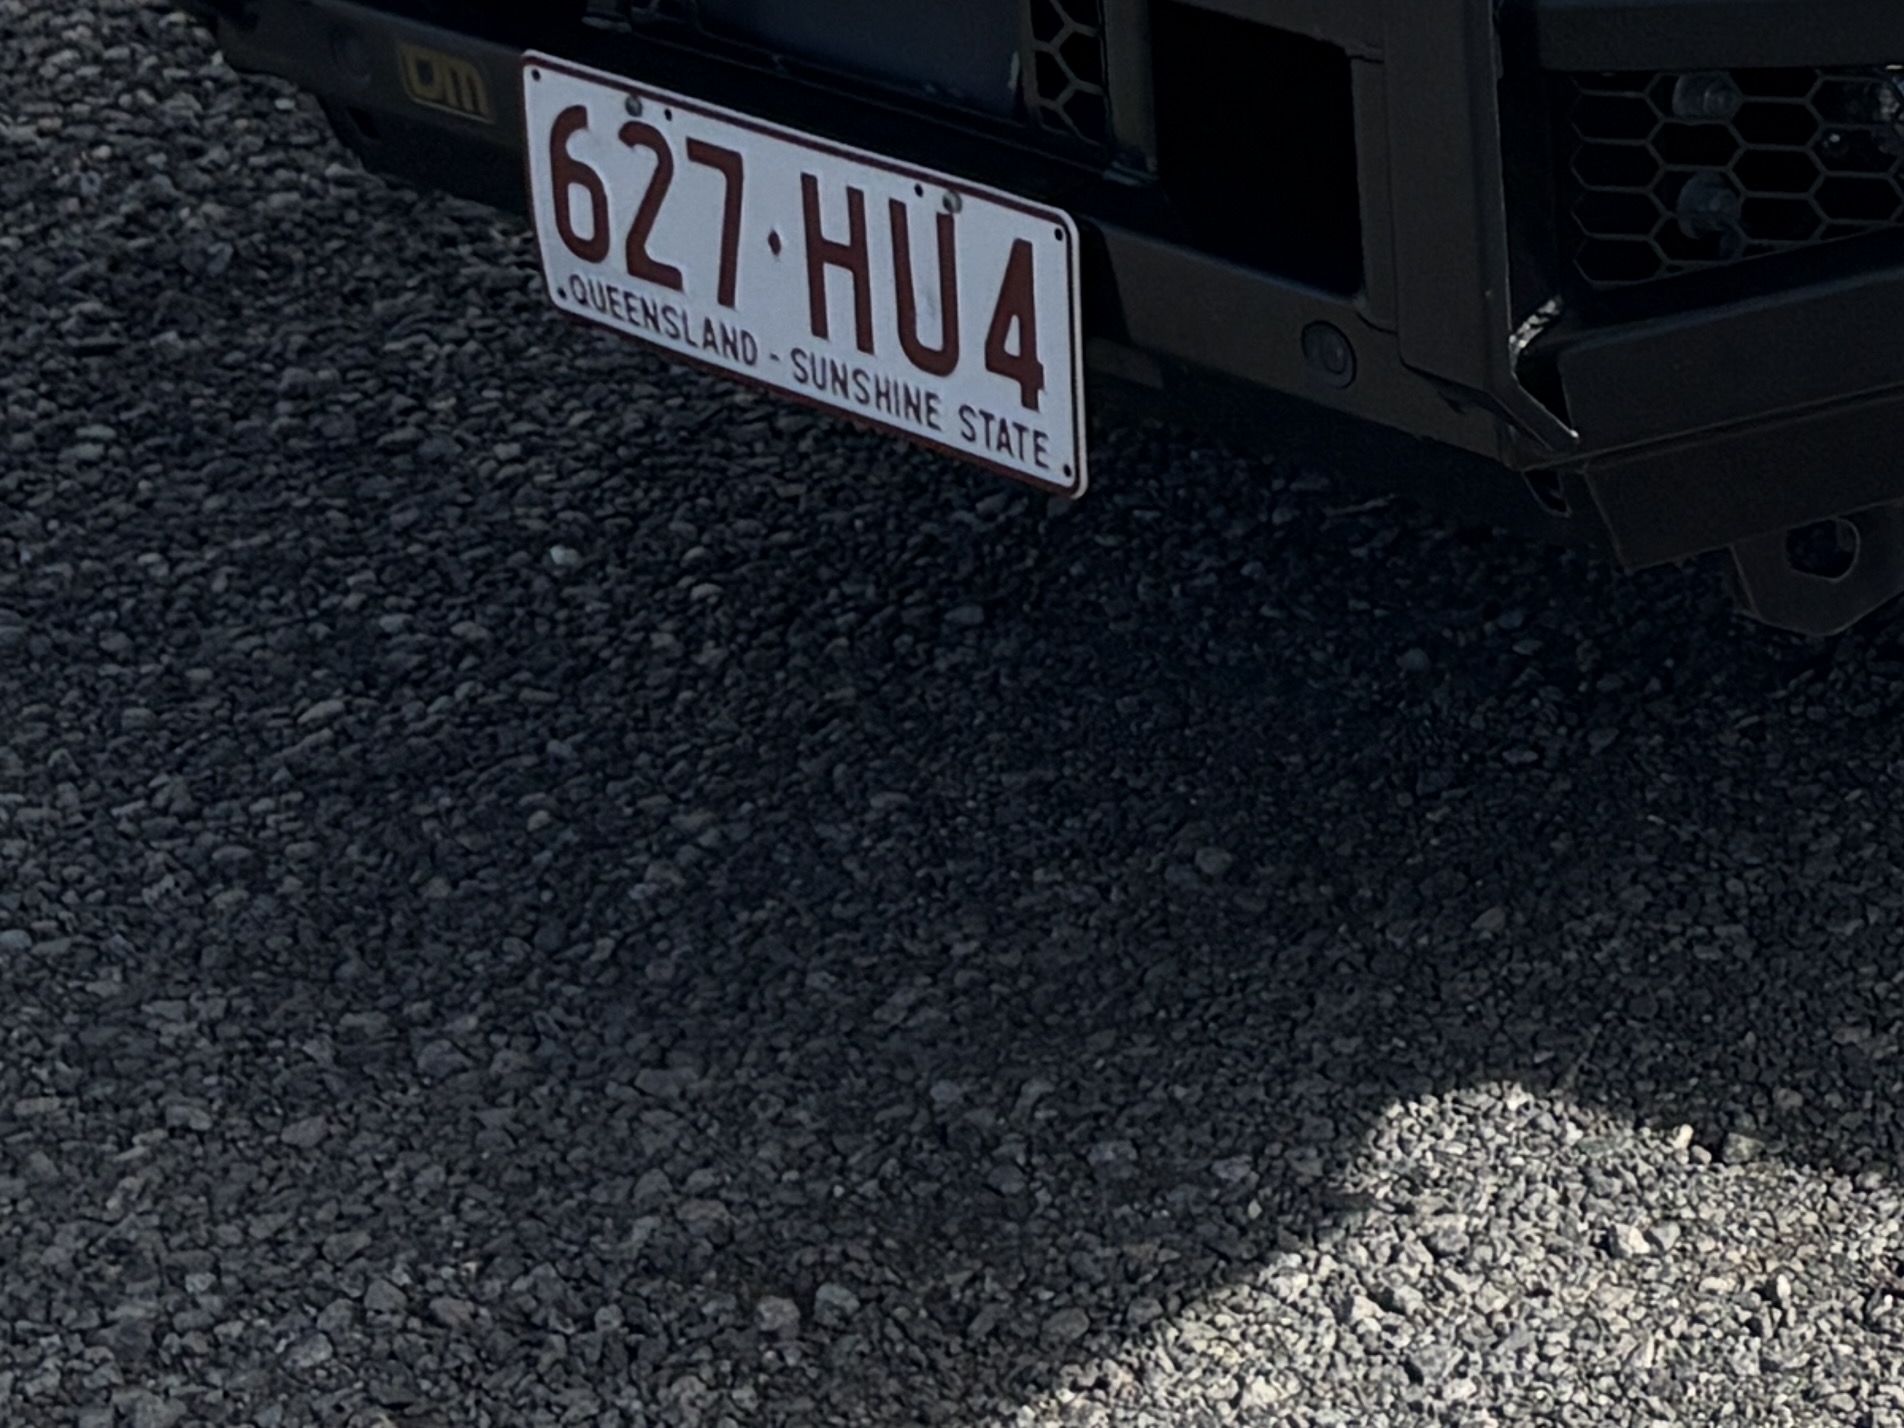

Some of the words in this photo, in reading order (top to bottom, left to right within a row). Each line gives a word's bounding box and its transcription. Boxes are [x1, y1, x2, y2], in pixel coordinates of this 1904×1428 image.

[568, 273, 759, 368] QUEENSLAND
[790, 348, 943, 432] SUNSHINE
[957, 404, 1051, 470] STATE
